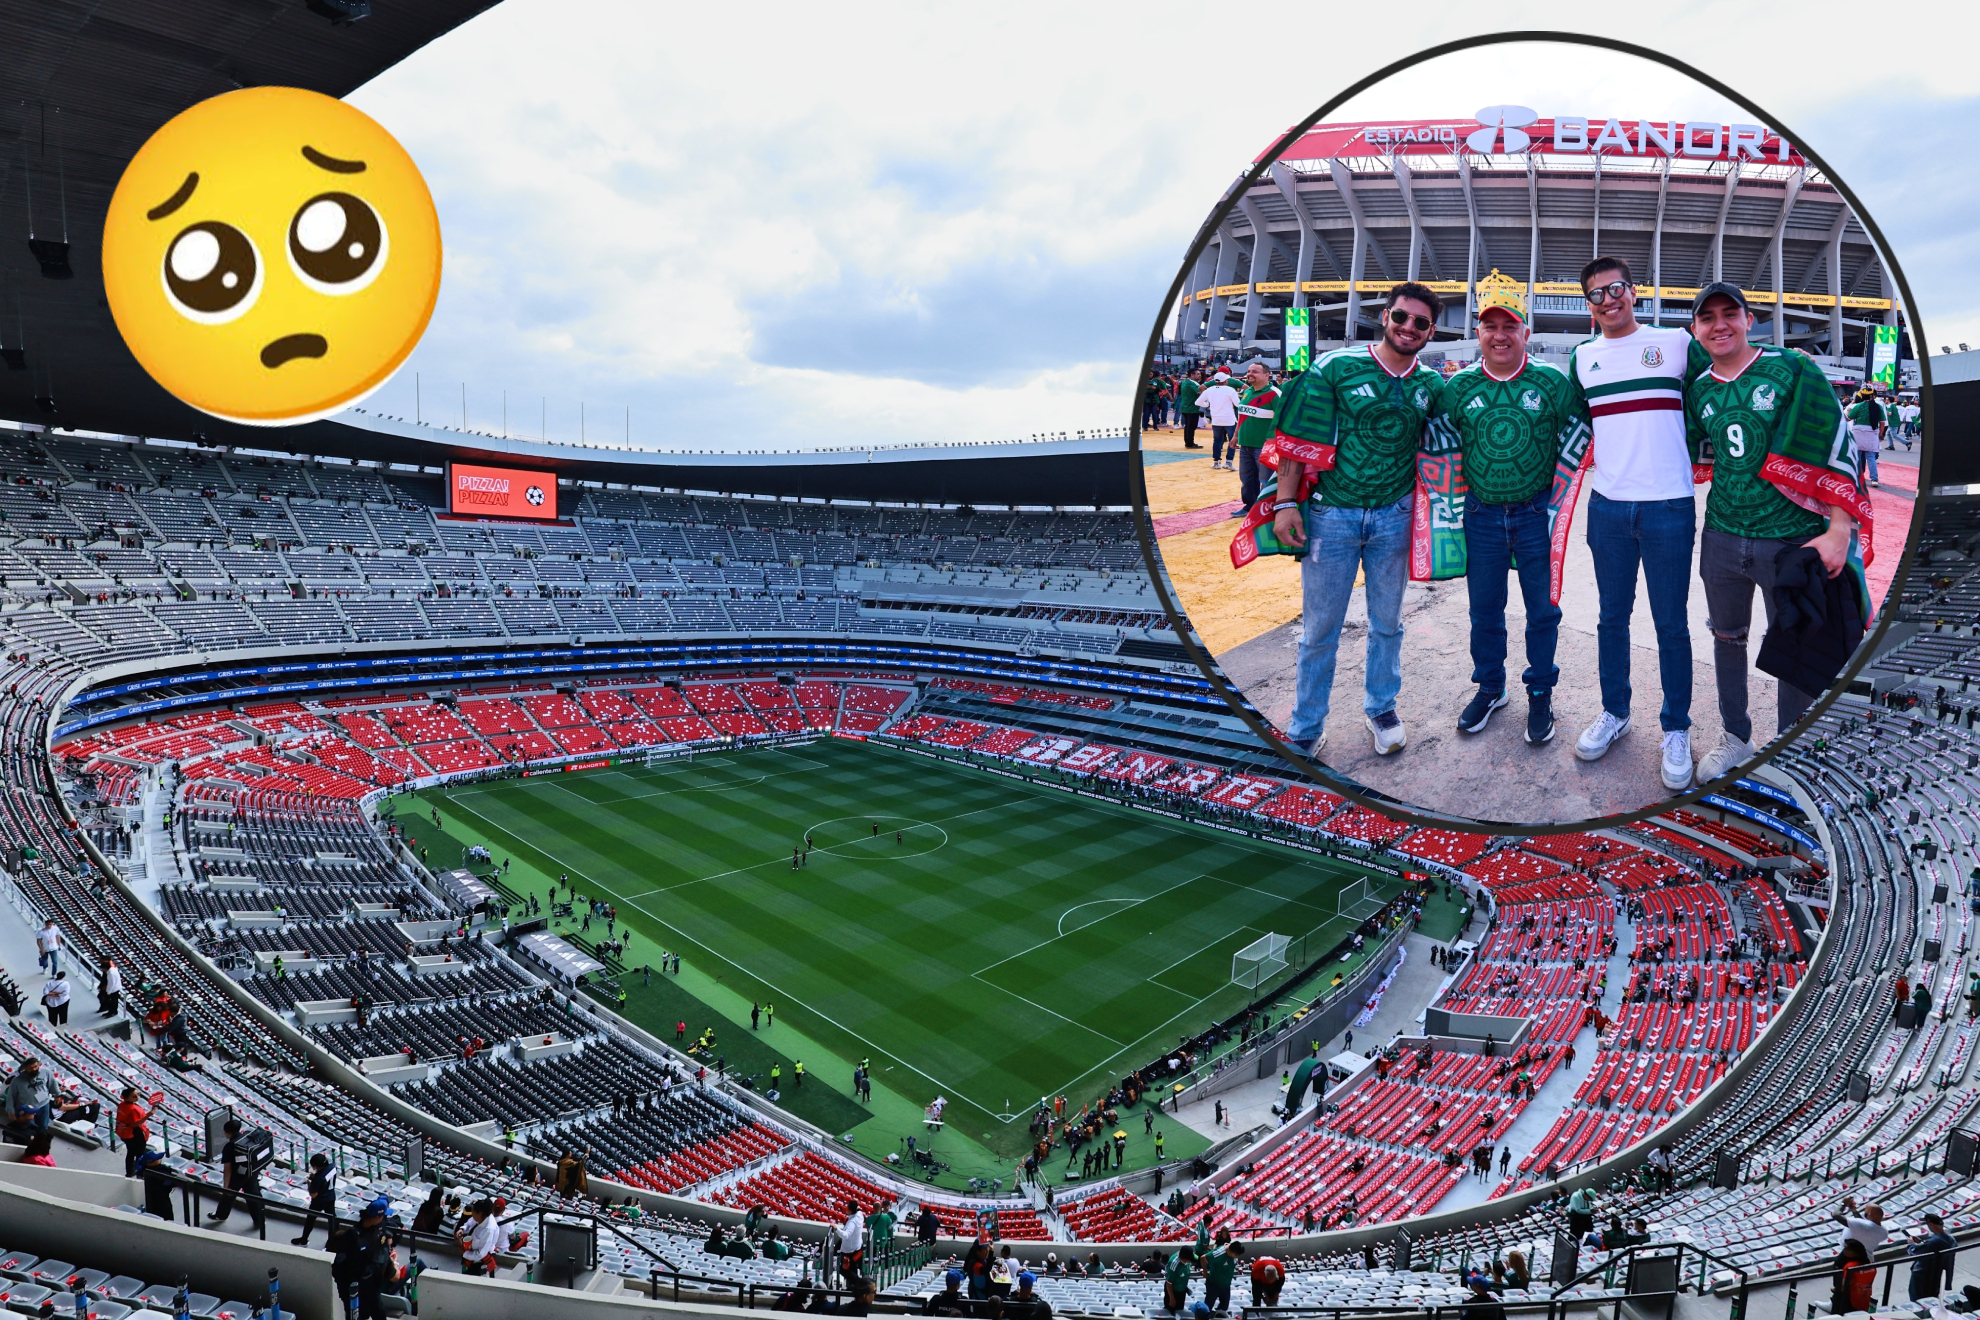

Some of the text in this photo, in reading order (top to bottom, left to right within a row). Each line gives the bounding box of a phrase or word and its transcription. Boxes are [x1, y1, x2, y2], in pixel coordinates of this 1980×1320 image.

[1364, 128, 1456, 143] ESTADIO
[1240, 406, 1257, 414] EXICO
[1726, 424, 1745, 457] 9
[458, 476, 509, 493] PIZZA!
[459, 490, 510, 506] PIZZA!
[530, 768, 562, 776] caliente.mx
[1049, 783, 1073, 792] ESFUERZO
[1077, 790, 1121, 804] SOMOS ESFUERZO
[1133, 804, 1181, 819] SOMOS ESFUERZO
[1194, 818, 1248, 836] SOMOS ESFUERZO
[1262, 836, 1322, 853] SOMOS ESFUERZO
[1337, 853, 1398, 876] SOMOS ESFUERZO
